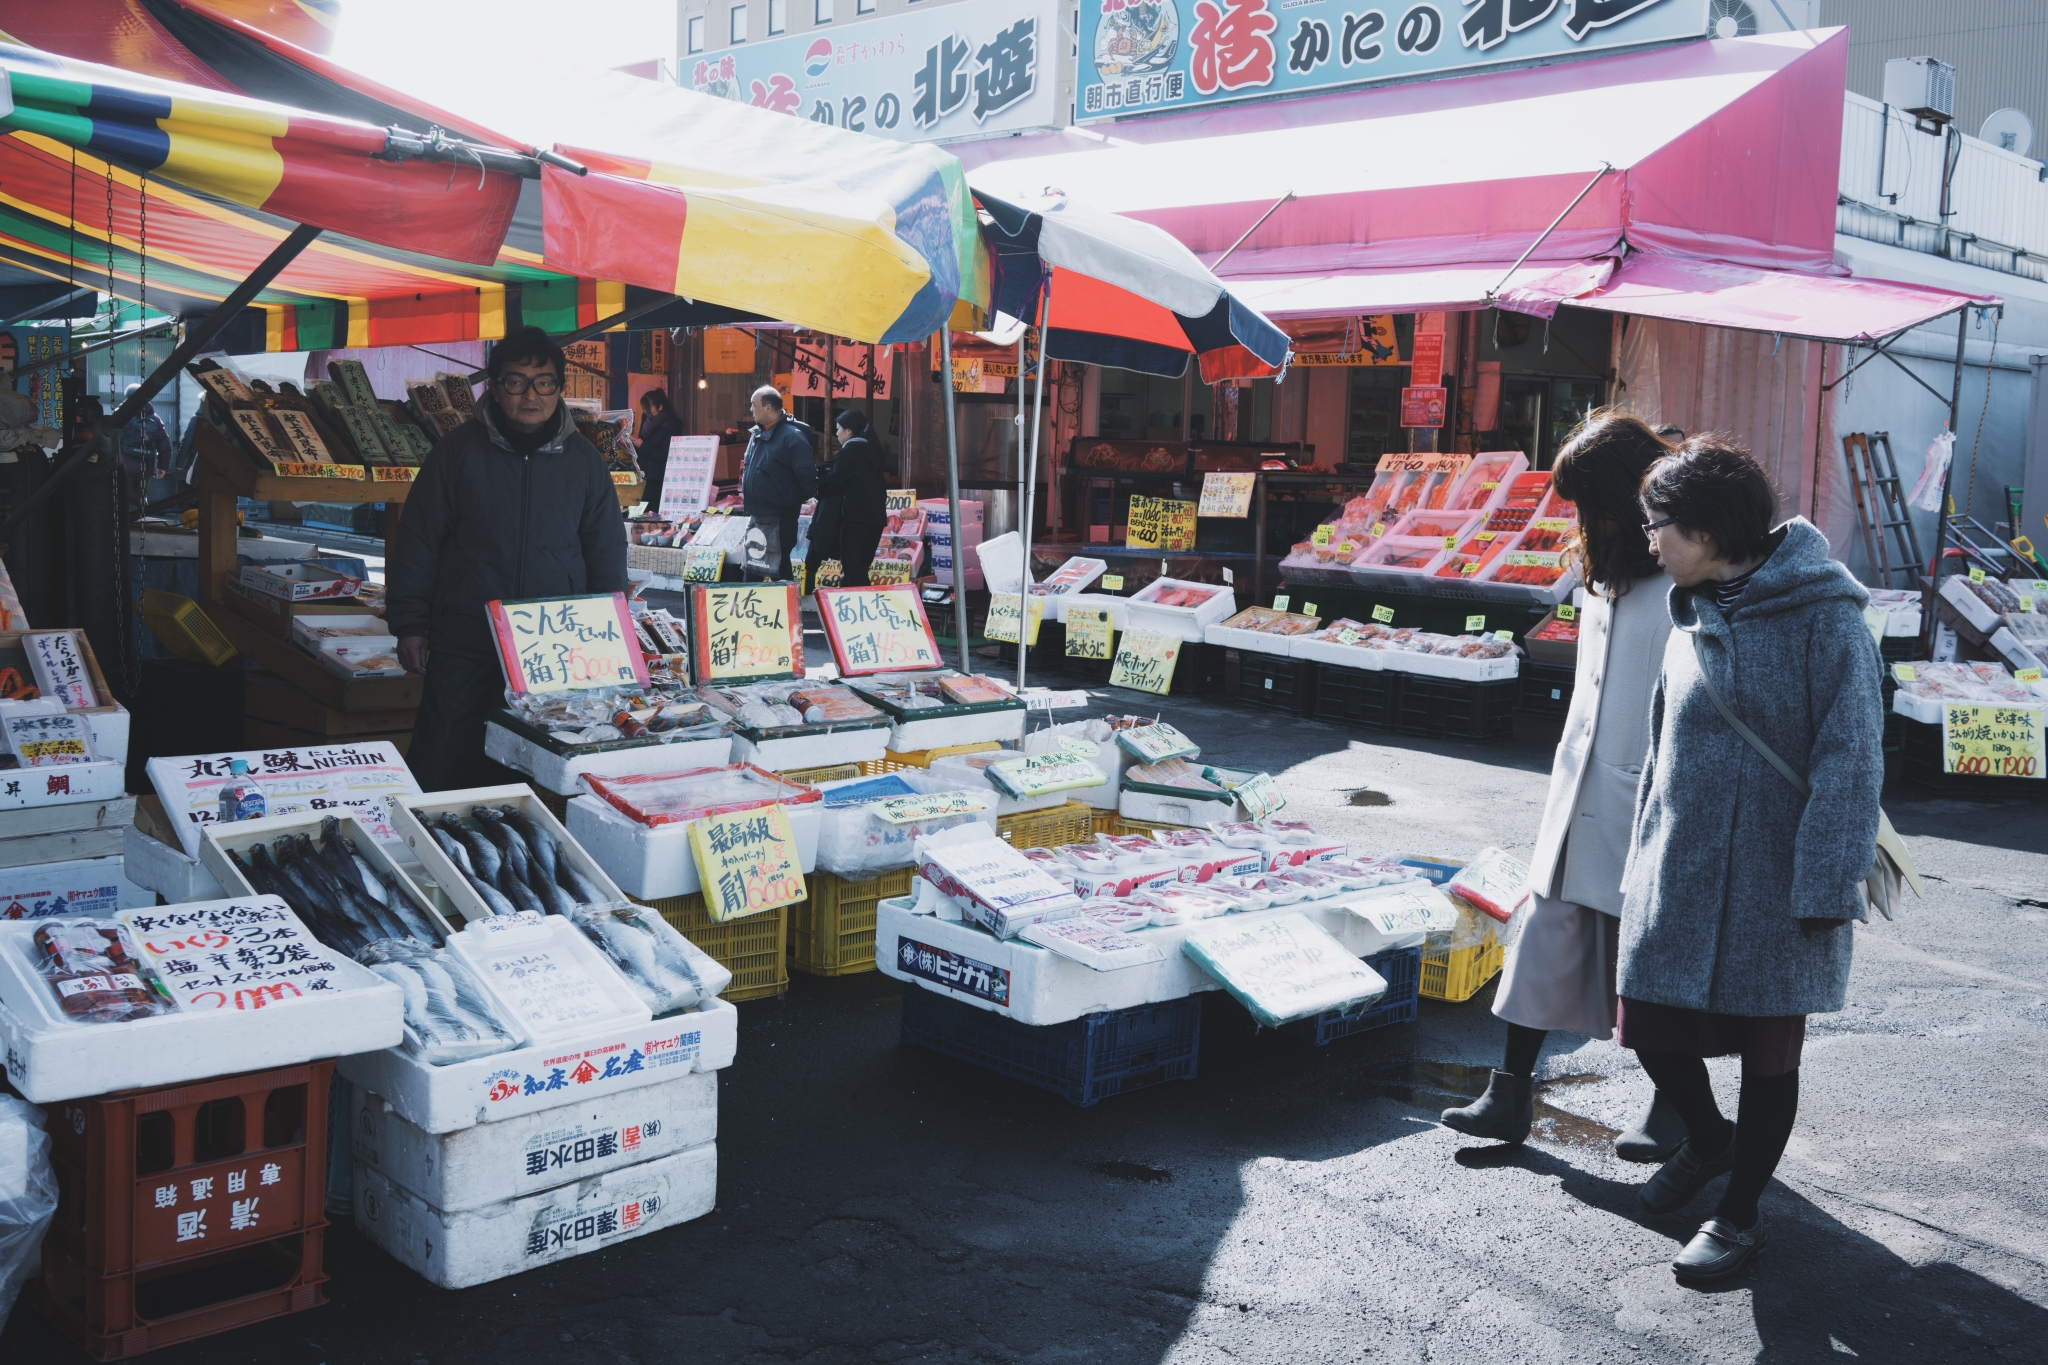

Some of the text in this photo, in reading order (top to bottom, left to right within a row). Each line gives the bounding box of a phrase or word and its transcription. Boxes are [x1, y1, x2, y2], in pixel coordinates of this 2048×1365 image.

[1287, 4, 1445, 74] かにの
[693, 55, 736, 86] 北の味
[911, 16, 1036, 128] 北遊
[1084, 72, 1185, 113] 朝市直行便
[512, 603, 620, 643] こんなセット
[711, 589, 784, 629] そんなセット
[834, 593, 923, 632] あんなセット
[1115, 650, 1160, 673] 根ホッケ
[1120, 670, 1165, 691] シマホッケ
[1995, 711, 2035, 728] ピリ辛味
[313, 752, 387, 771] NISHIN
[47, 775, 70, 796] 鯛
[707, 816, 786, 855] 最高級
[28, 896, 69, 919] 名産
[543, 1053, 581, 1067] 世界遺産の地
[644, 1030, 701, 1056] (有)ヤマユウ関商店
[523, 1068, 569, 1096] 知床
[597, 1049, 646, 1081] 名産
[643, 1120, 661, 1139] (株)
[526, 1131, 618, 1176] 澤田水産
[155, 1163, 281, 1209] 専用通箱
[642, 1196, 661, 1215] (株)
[176, 1197, 260, 1243] 清酒
[526, 1208, 618, 1256] 澤田水産
